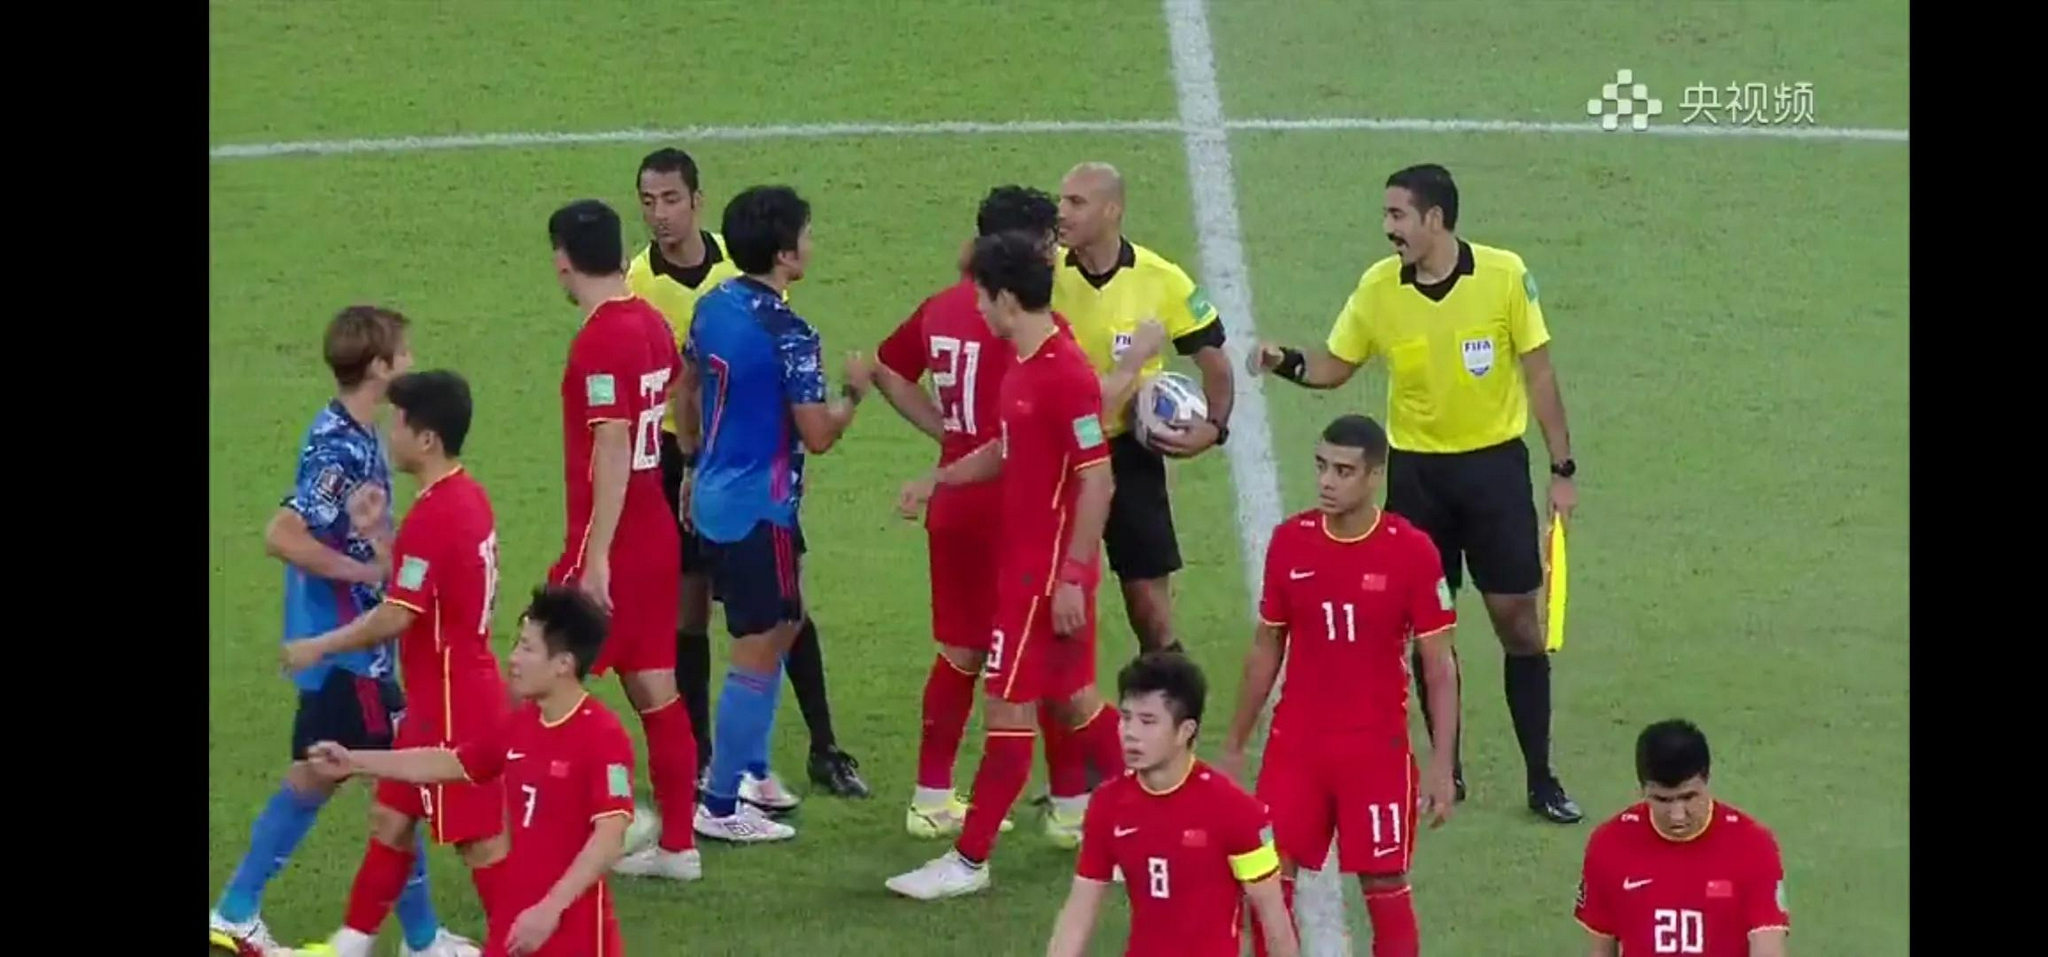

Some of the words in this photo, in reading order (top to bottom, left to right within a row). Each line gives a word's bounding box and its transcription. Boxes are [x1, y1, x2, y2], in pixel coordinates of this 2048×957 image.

[1464, 340, 1491, 352] FIFA
[930, 335, 981, 436] 21
[1321, 601, 1356, 642] 11
[521, 783, 537, 828] 7
[1368, 802, 1400, 843] 11
[1148, 857, 1170, 899] 8
[1654, 908, 1703, 953] 20
